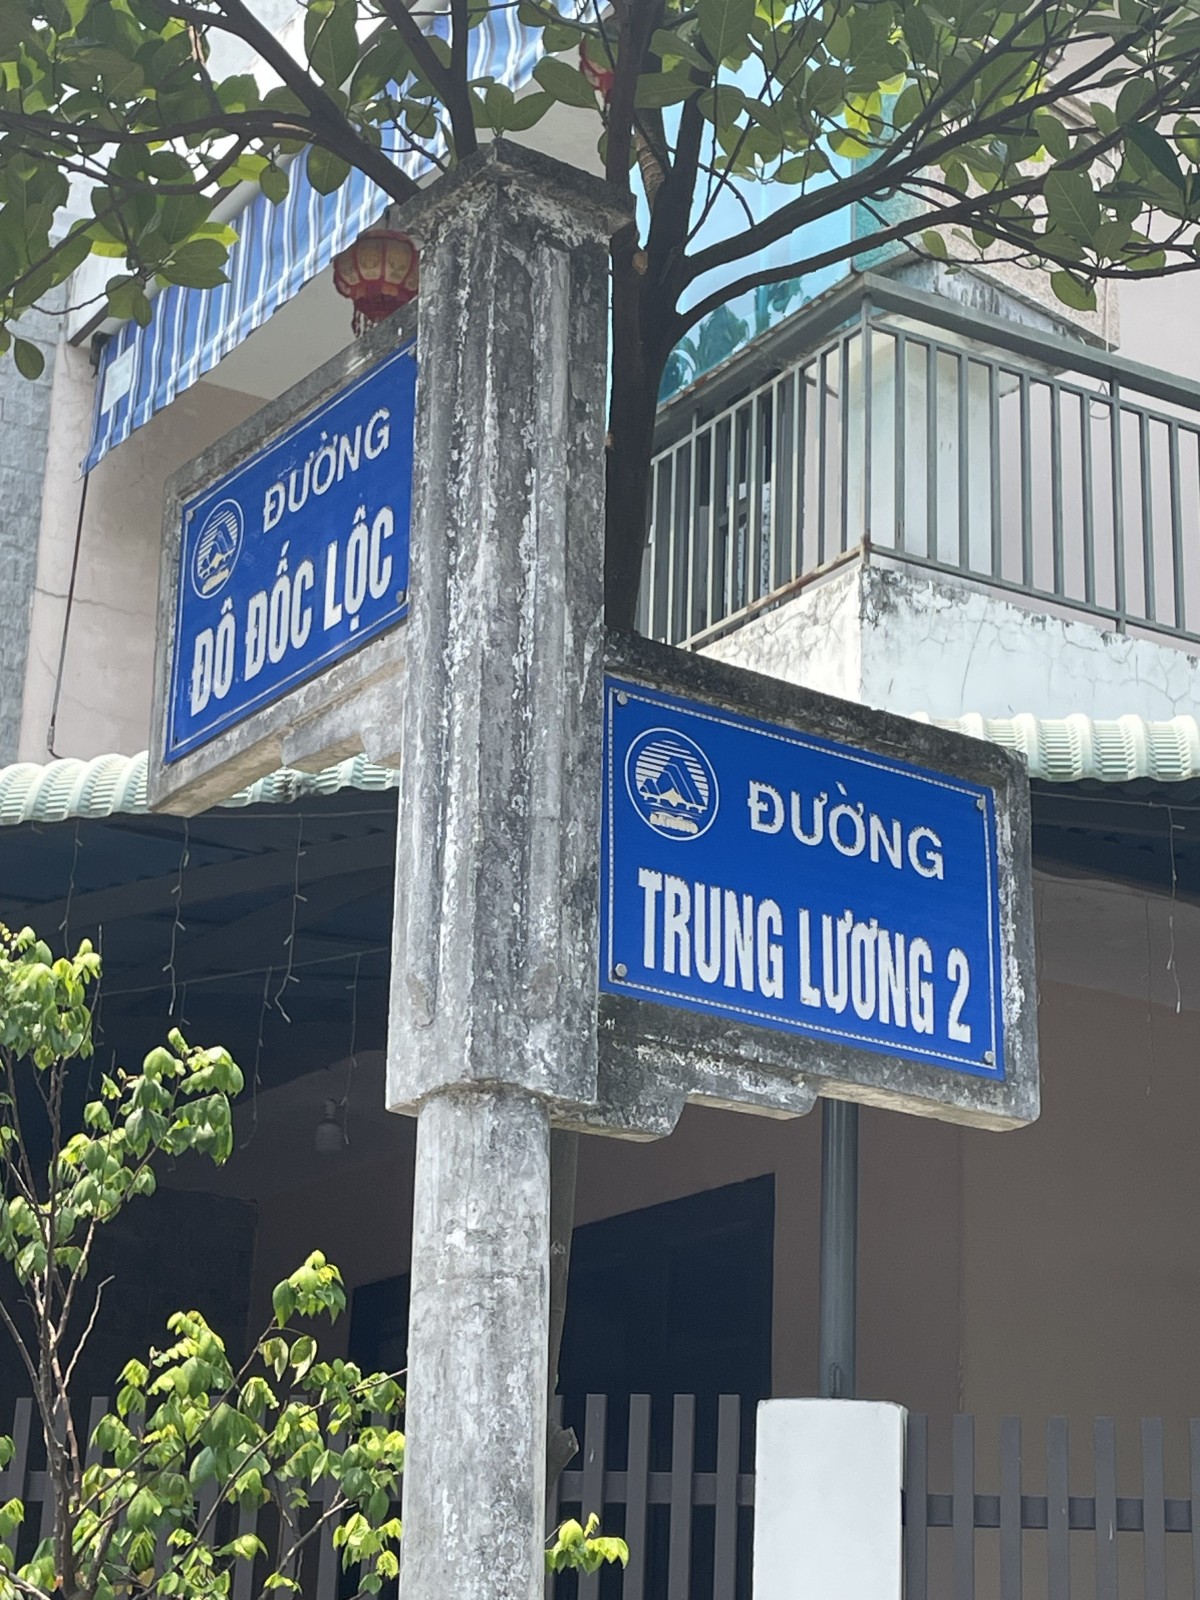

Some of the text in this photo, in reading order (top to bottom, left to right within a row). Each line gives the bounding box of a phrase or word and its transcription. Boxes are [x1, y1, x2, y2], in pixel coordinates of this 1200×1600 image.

[263, 408, 390, 533] ĐƯỜNG
[191, 503, 394, 717] ĐÔ ĐỐC LỘC
[747, 780, 944, 880] ĐƯỜNG
[638, 867, 972, 1044] TRUNG LƯƠNG 2
